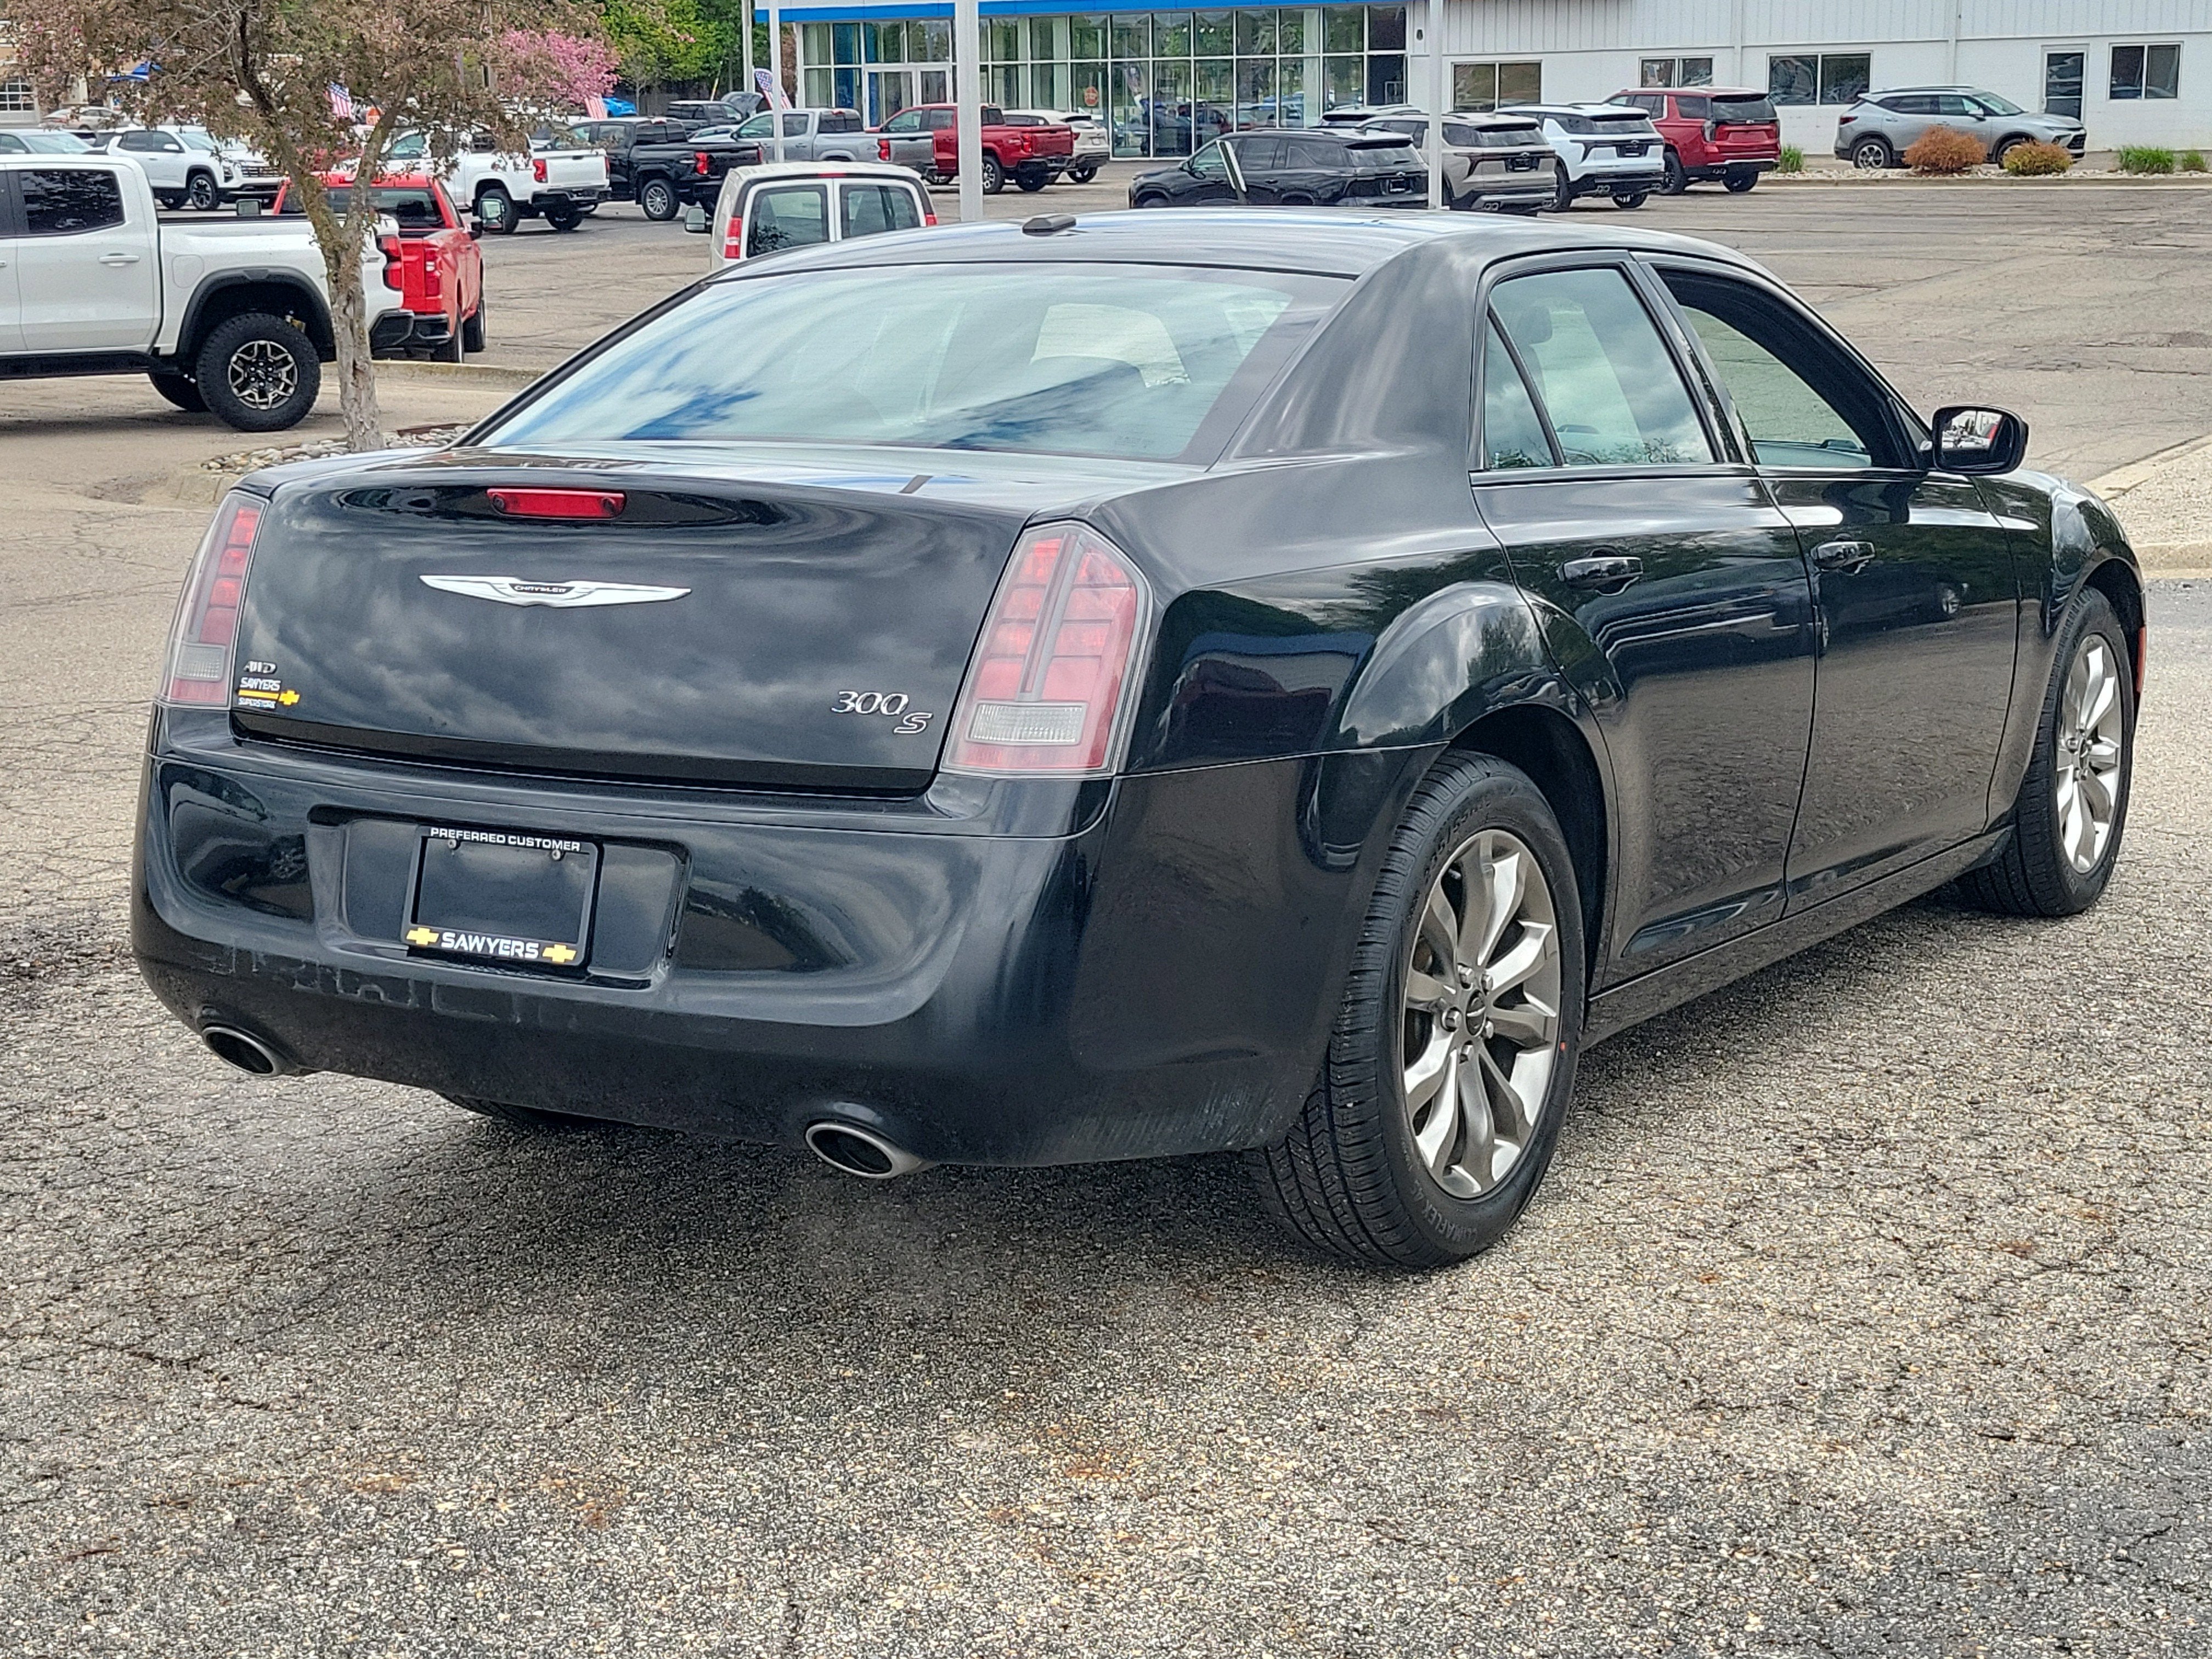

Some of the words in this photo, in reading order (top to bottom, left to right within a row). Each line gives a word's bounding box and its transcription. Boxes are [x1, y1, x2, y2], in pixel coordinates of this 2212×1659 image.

[240, 677, 281, 691] SAWYERS
[831, 691, 909, 715] 300
[894, 712, 933, 734] S
[430, 827, 506, 844] PREFERRED
[508, 836, 580, 851] CUSTOMER
[441, 932, 539, 960] SAWYERS
